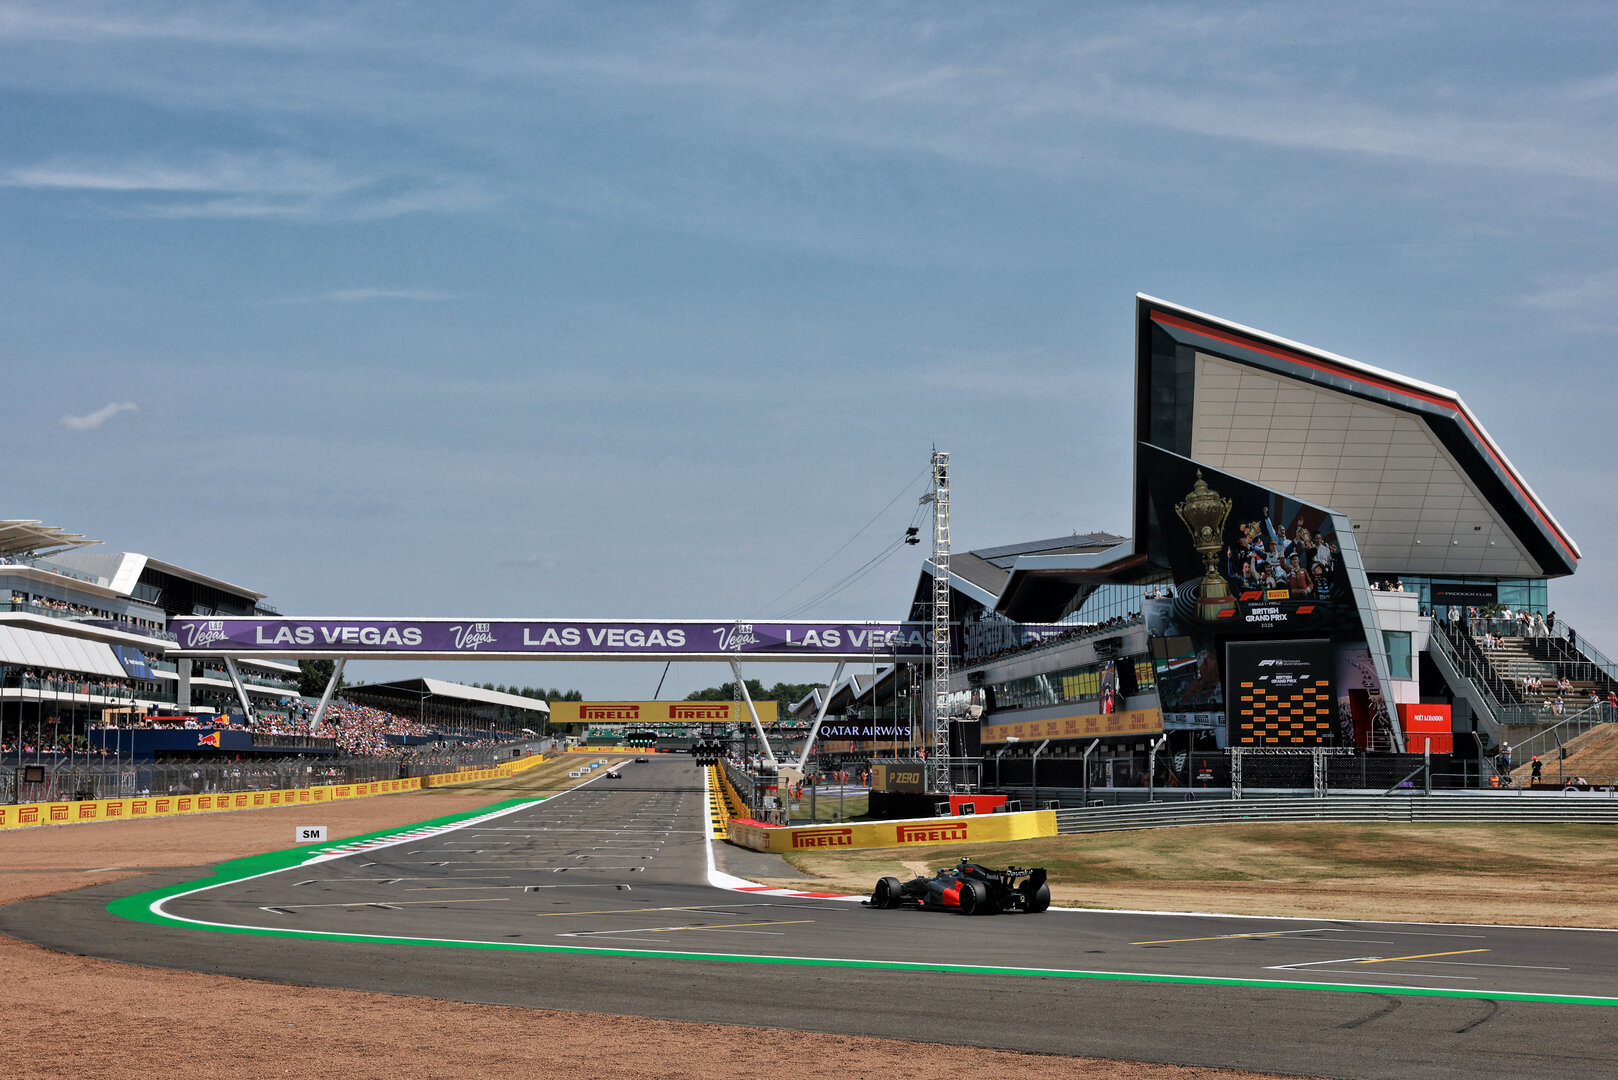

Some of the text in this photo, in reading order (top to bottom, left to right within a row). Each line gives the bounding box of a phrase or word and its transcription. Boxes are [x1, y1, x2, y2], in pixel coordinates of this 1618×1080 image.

[1245, 613, 1288, 622] GRAND PRIX
[1251, 607, 1279, 615] BRITISH
[182, 623, 229, 647] Vegas
[256, 626, 422, 646] LAS VEGAS
[450, 626, 497, 650] Vegas
[523, 628, 686, 647] LAS VEGAS
[713, 627, 760, 650] Vegas
[786, 629, 841, 647] LAS
[580, 705, 639, 719] PIRELLI
[669, 705, 729, 718] PIRELLI
[821, 726, 911, 737] QATAR AIRWAYS
[889, 772, 895, 783] P
[896, 772, 920, 784] ZERO
[50, 805, 68, 821] PIRELLI
[79, 804, 97, 818] PIRELLI
[106, 802, 122, 816] PIRELLI
[132, 800, 147, 815] PIRELLI
[156, 799, 170, 813] PIRELLI
[19, 807, 38, 823] PIRELLI
[302, 830, 320, 838] SM
[792, 828, 852, 847] PIRELLI
[896, 822, 967, 842] PIRELLI
[1006, 869, 1033, 877] Revolut
